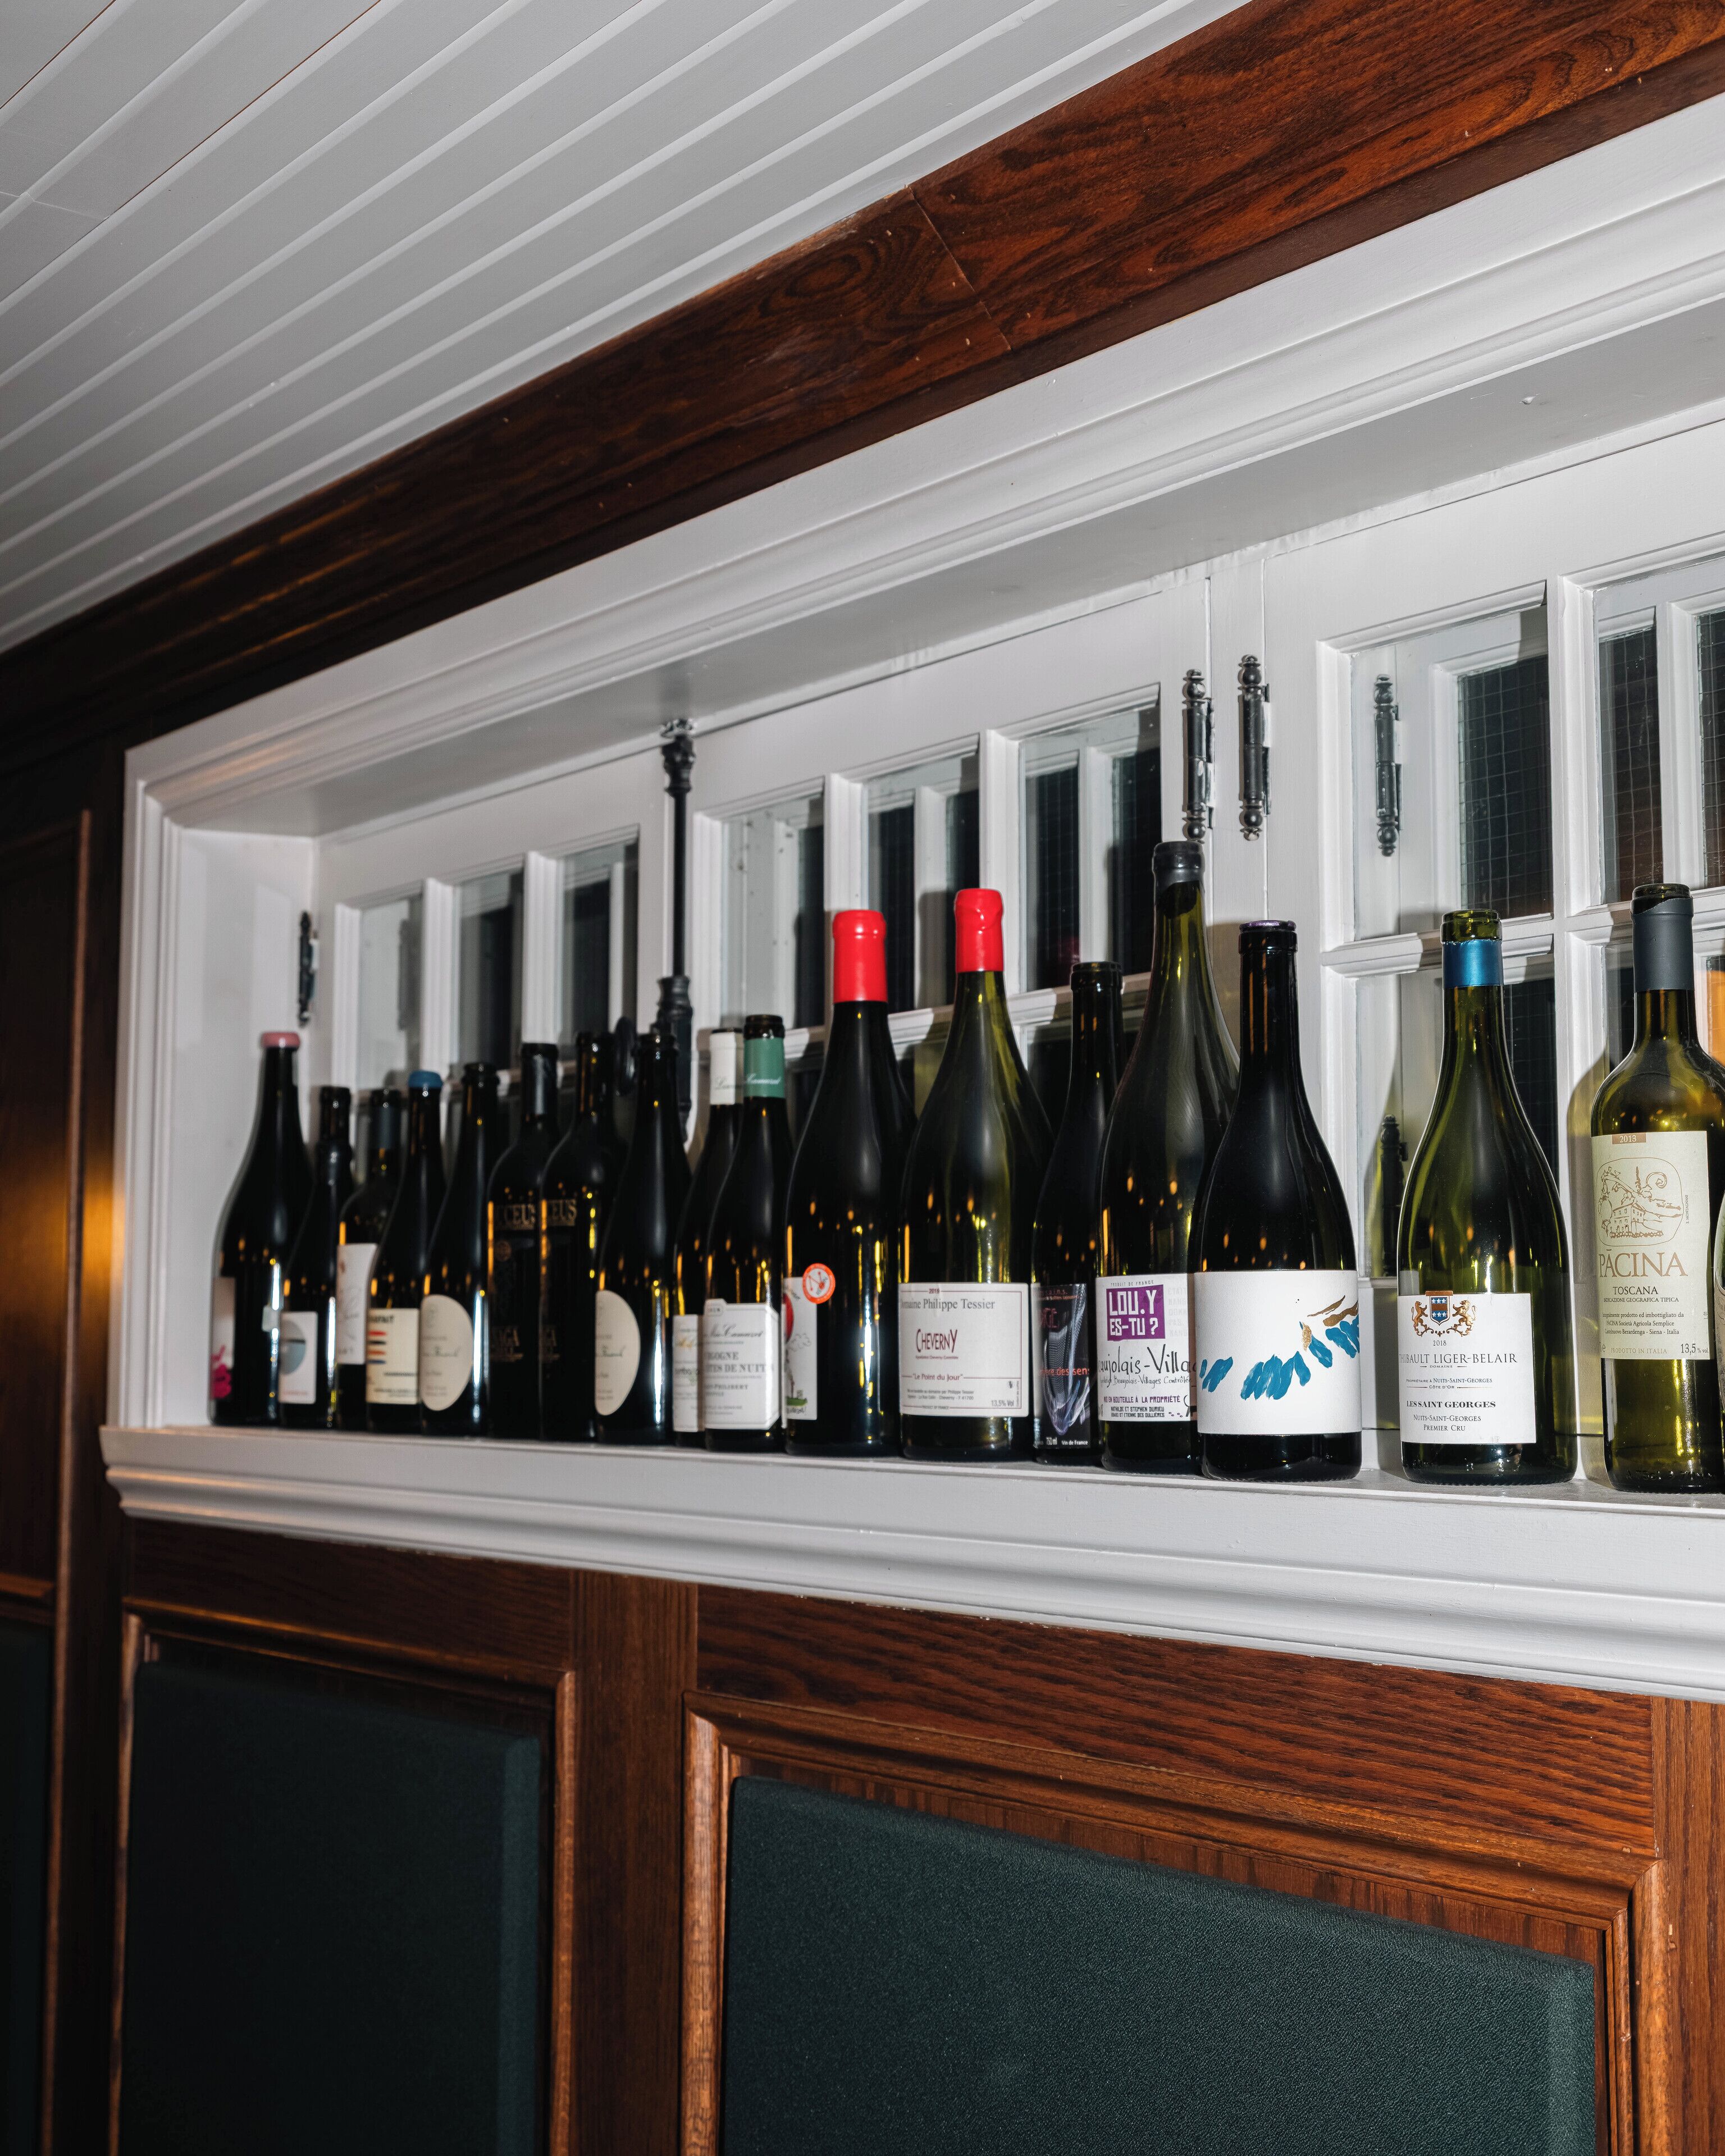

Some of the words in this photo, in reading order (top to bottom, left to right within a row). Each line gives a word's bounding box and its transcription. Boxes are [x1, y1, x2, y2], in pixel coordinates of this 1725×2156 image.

[1619, 1135, 1637, 1143] 2013
[1613, 1286, 1659, 1295] TOSCANA
[923, 1298, 958, 1312] Philippe
[961, 1298, 995, 1309] Tessier
[1110, 1317, 1146, 1336] ES-TU
[916, 1328, 958, 1353] CHEVERNY
[1681, 1343, 1696, 1355] 13,5
[1399, 1354, 1430, 1364] THIBAULT
[1434, 1353, 1517, 1364] LIGER-BELAIR
[724, 1364, 737, 1373] DE
[1053, 1437, 1057, 1445] ml
